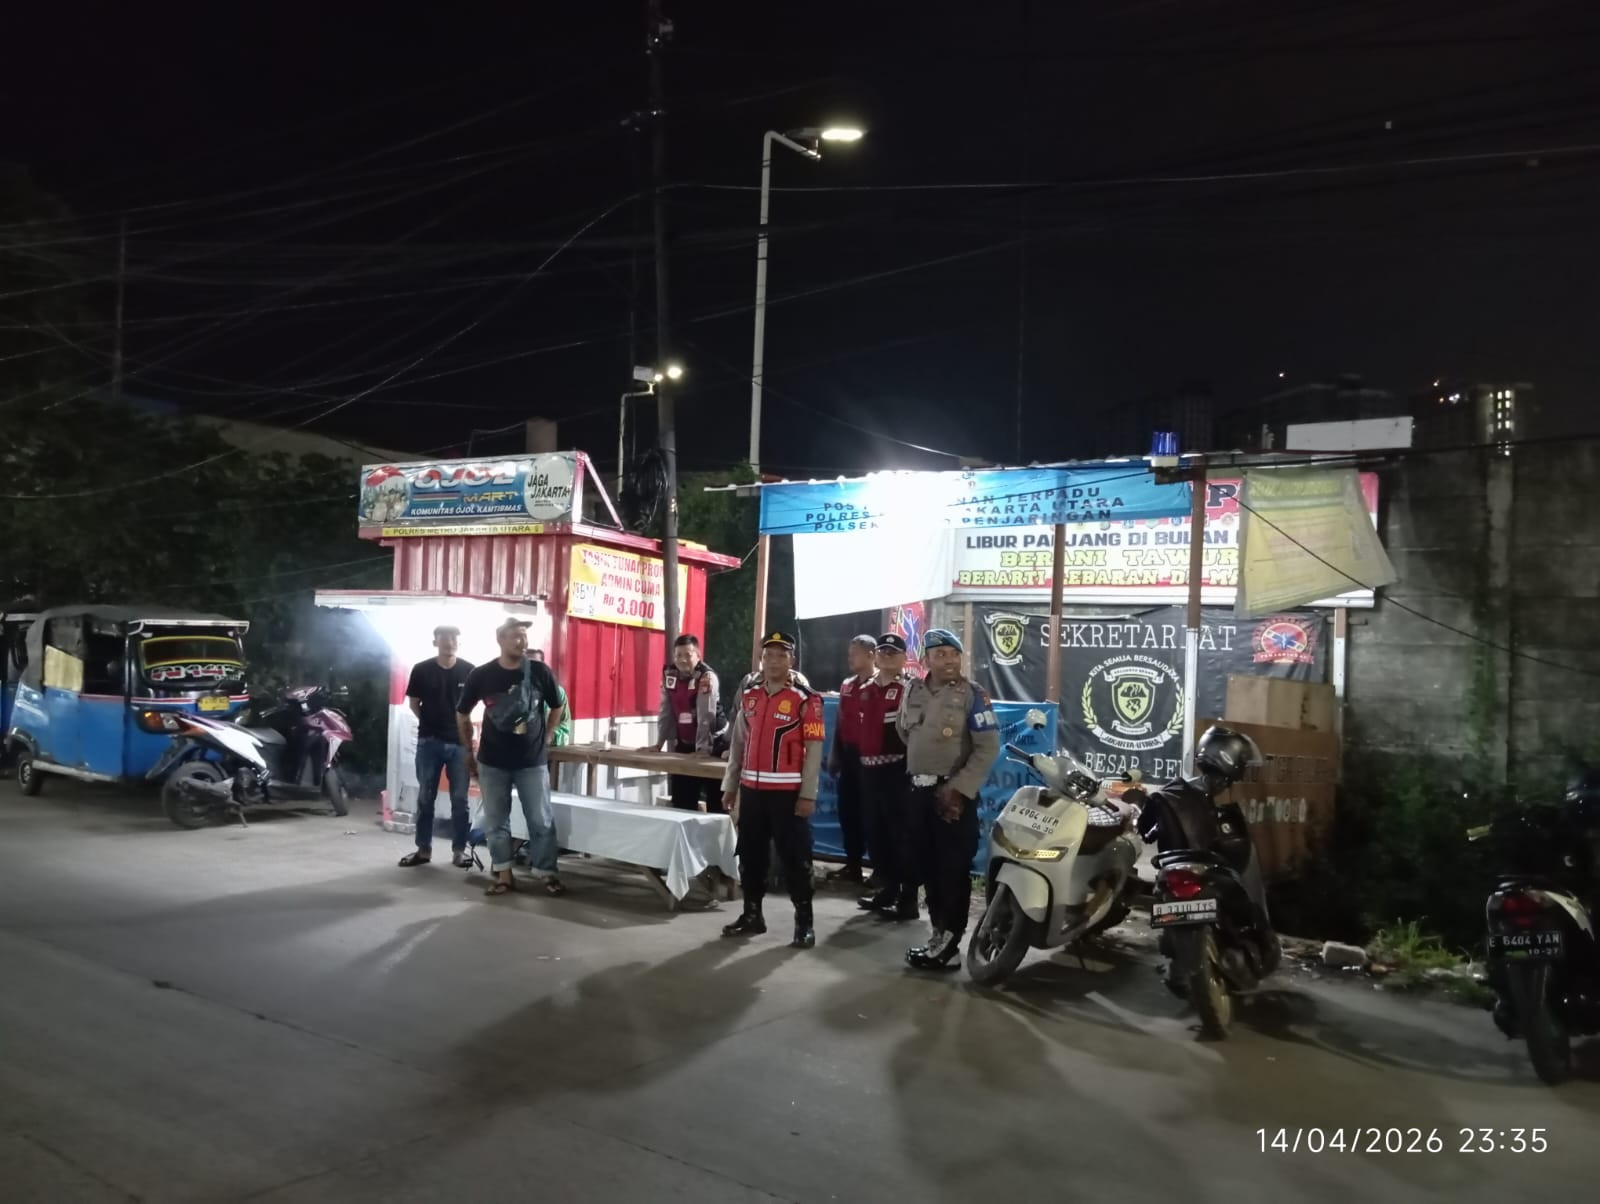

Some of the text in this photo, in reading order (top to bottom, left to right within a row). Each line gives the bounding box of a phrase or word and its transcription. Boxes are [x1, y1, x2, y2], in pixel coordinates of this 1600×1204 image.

[527, 473, 549, 487] JAGA
[411, 507, 454, 516] KOMUNITAS
[805, 511, 871, 522] POLRES
[1052, 497, 1125, 511] UTARA
[961, 509, 1112, 526] PENJARINGAN
[966, 535, 1018, 549] LIBUR
[1023, 532, 1122, 548] PAJANG
[1128, 532, 1148, 546] DI
[958, 569, 1047, 586] BERARTI
[634, 579, 660, 597] CUMA
[616, 597, 655, 619] 3.000
[1088, 664, 1105, 678] KITA
[1103, 655, 1132, 667] SEMUA
